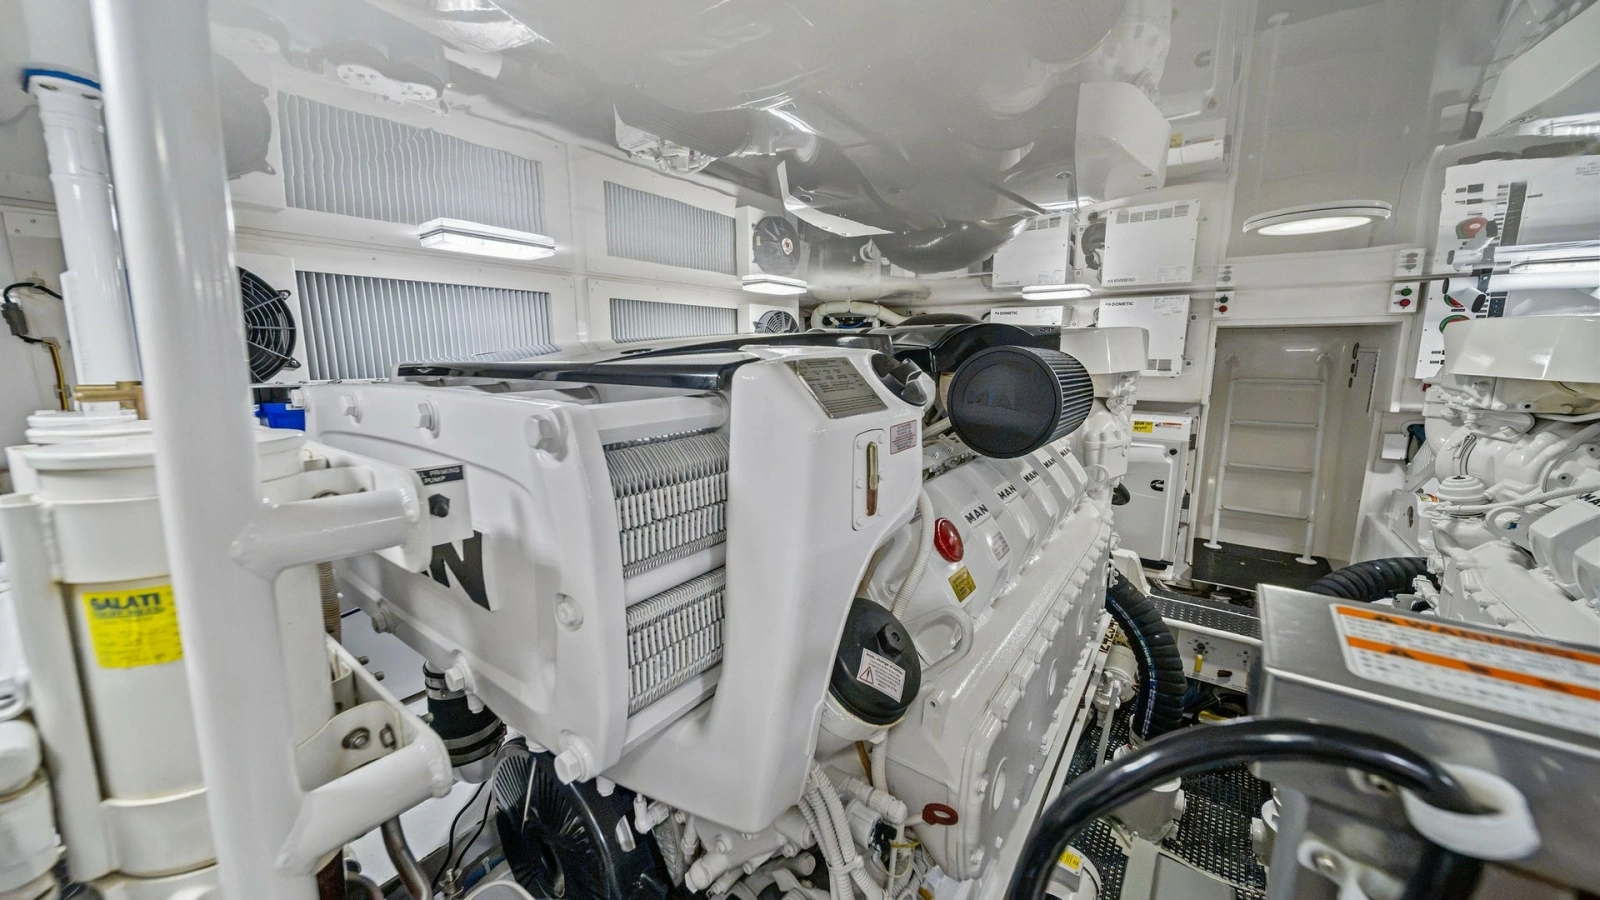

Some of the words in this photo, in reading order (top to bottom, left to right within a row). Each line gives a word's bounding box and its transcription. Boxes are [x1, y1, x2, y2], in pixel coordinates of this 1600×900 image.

[1059, 447, 1071, 458] MAN
[1043, 457, 1057, 469] MAN
[423, 475, 446, 484] PUMP
[1023, 469, 1039, 483] MAN
[997, 484, 1017, 501] MAN
[1580, 491, 1600, 507] MA
[964, 504, 989, 524] MAN
